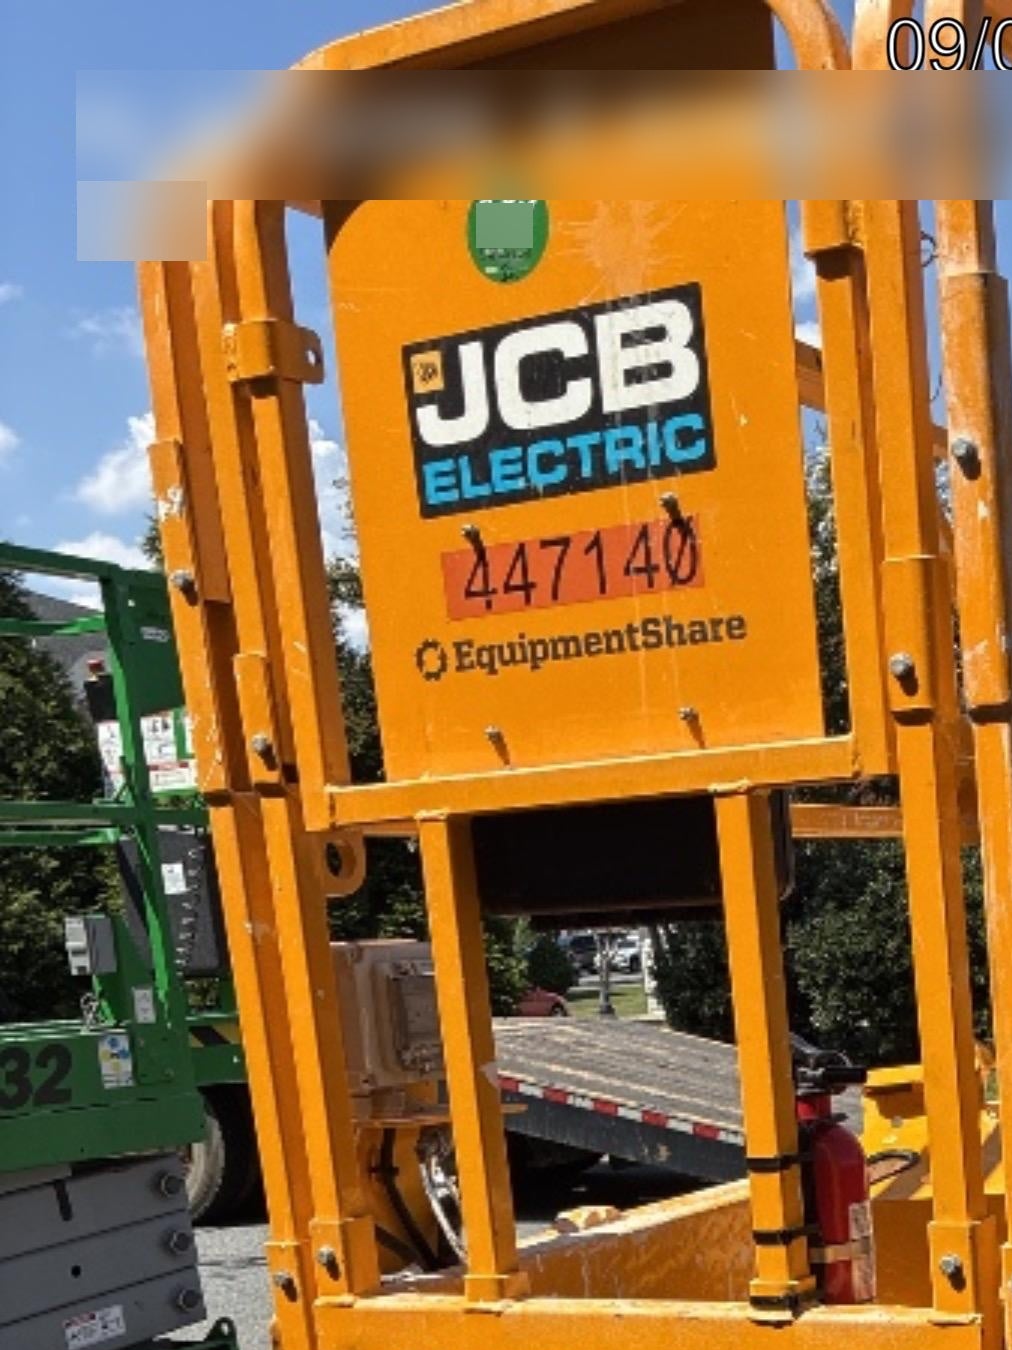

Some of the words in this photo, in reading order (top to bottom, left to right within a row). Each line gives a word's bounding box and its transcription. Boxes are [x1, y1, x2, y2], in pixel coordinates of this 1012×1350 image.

[416, 299, 701, 447] JCB
[422, 412, 706, 506] ELECTRIC
[464, 515, 699, 610] 447140
[453, 613, 747, 676] EquipmentShare
